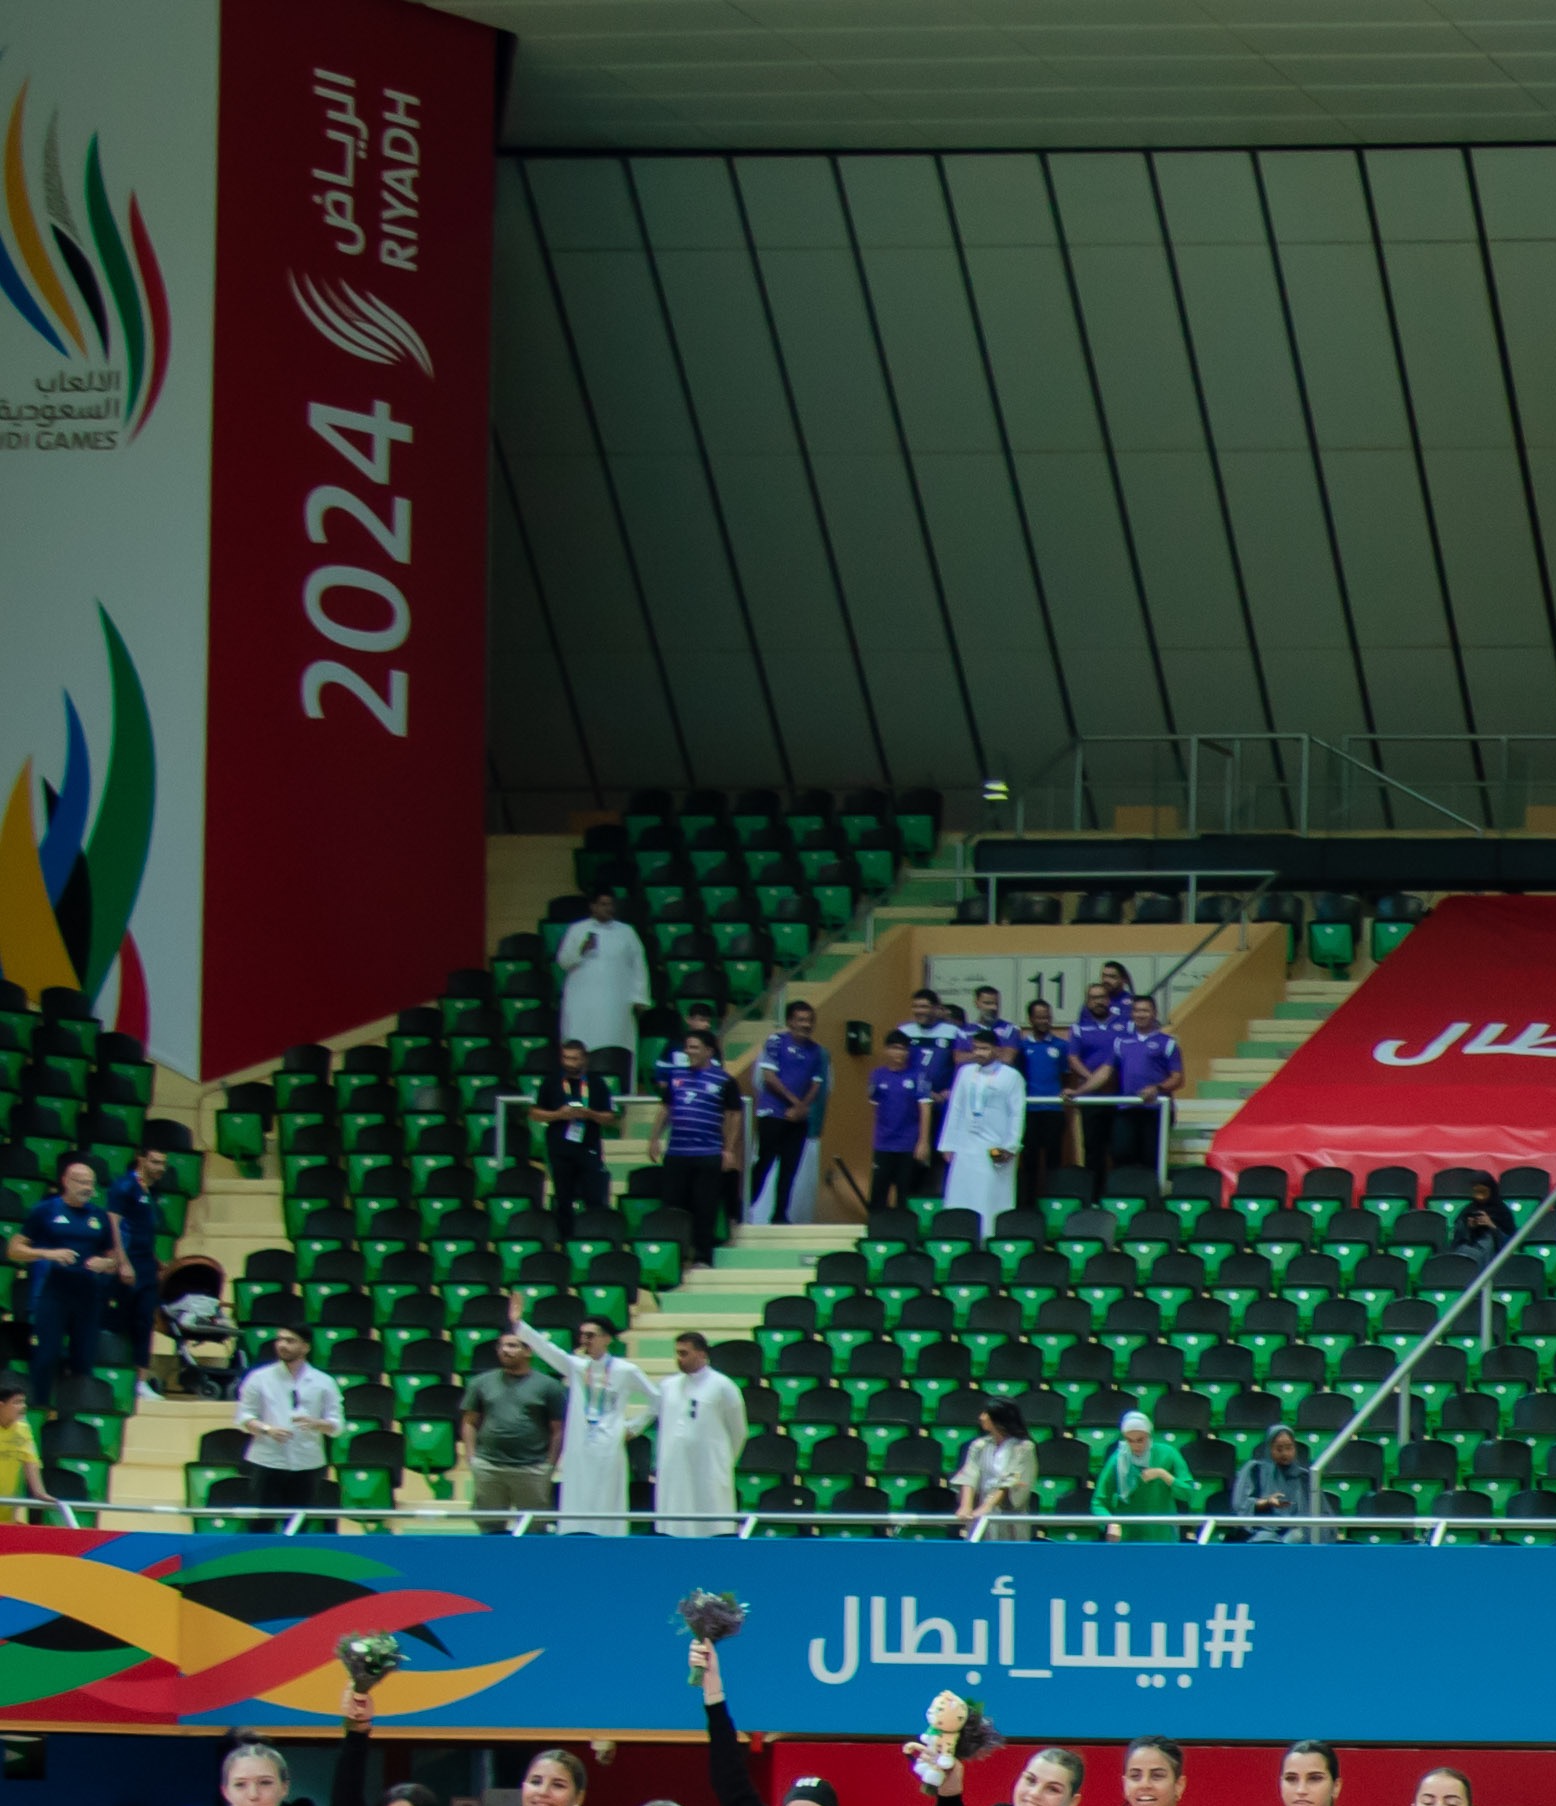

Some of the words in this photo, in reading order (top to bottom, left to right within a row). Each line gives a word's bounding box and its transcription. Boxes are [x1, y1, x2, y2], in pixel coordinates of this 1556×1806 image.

[313, 68, 368, 255] الرياض
[381, 89, 420, 270] RIYADH
[34, 431, 117, 453] GAMES
[302, 400, 412, 736] 2024
[1027, 971, 1065, 1009] 11
[809, 1576, 1254, 1688] #بيننا_أبطال
